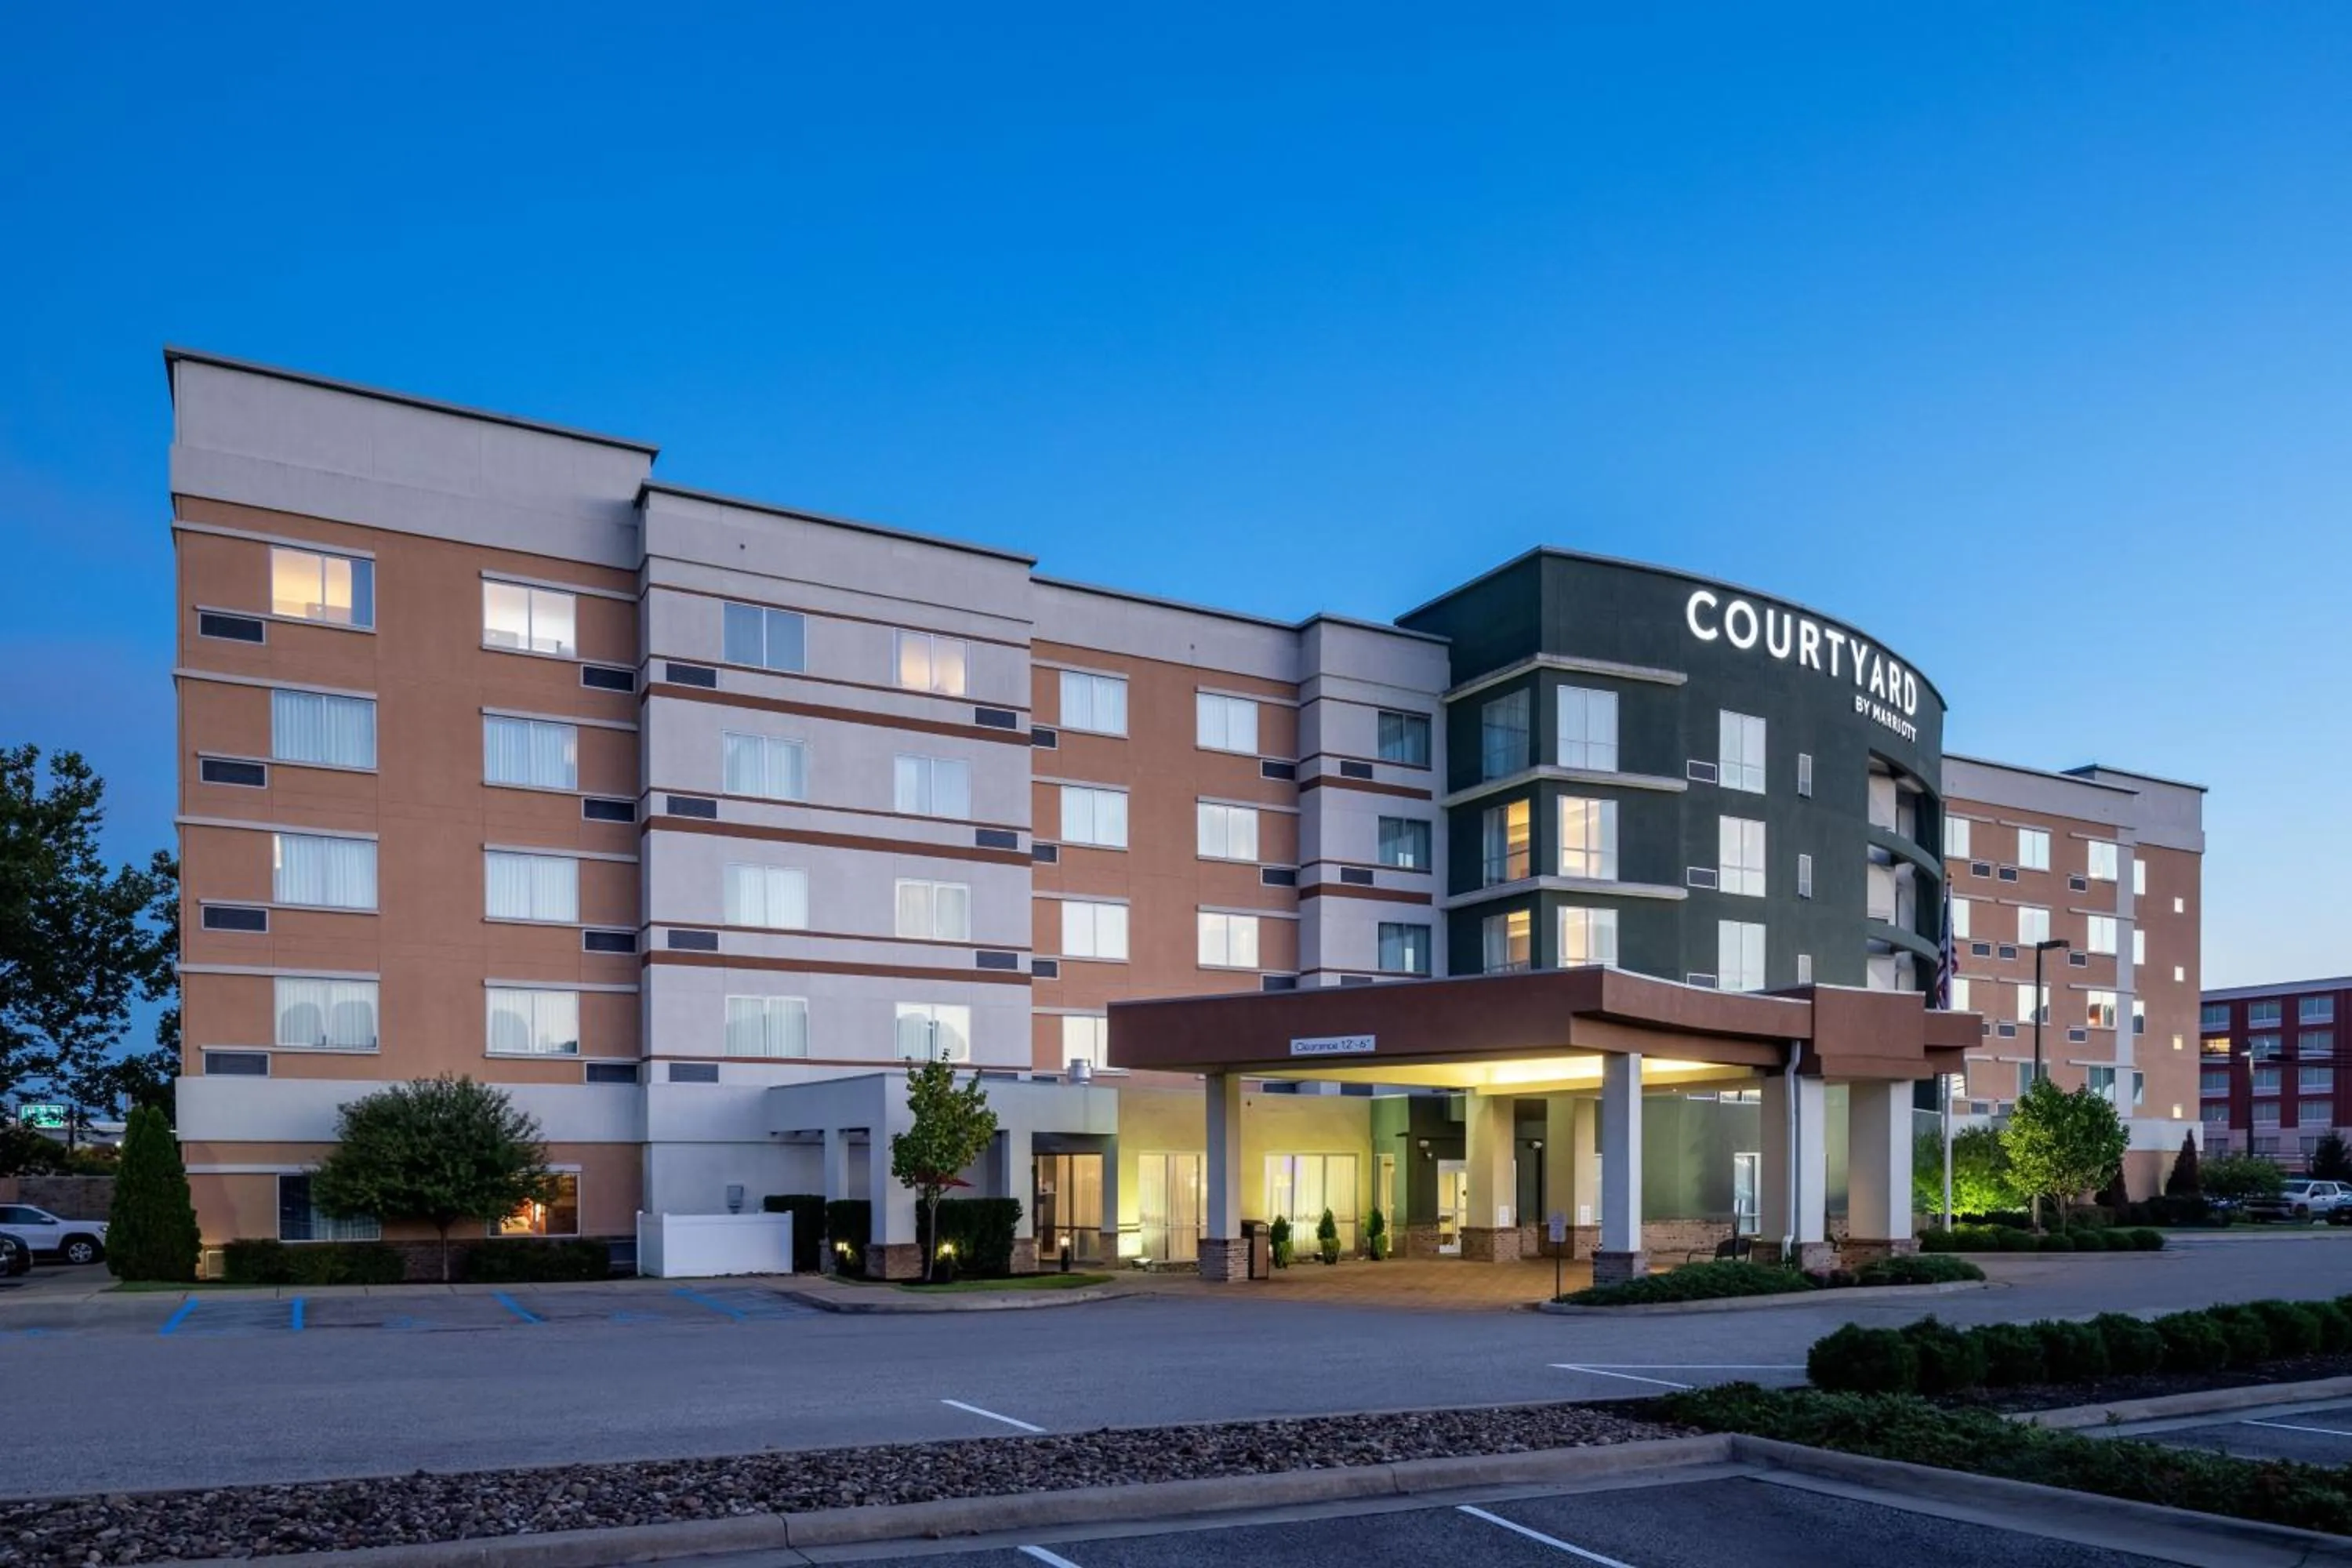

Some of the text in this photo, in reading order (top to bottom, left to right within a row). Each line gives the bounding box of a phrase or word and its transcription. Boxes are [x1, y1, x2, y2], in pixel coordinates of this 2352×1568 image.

[1686, 590, 1918, 716] COURTYARD
[1856, 695, 1917, 743] BY MARRIOTT
